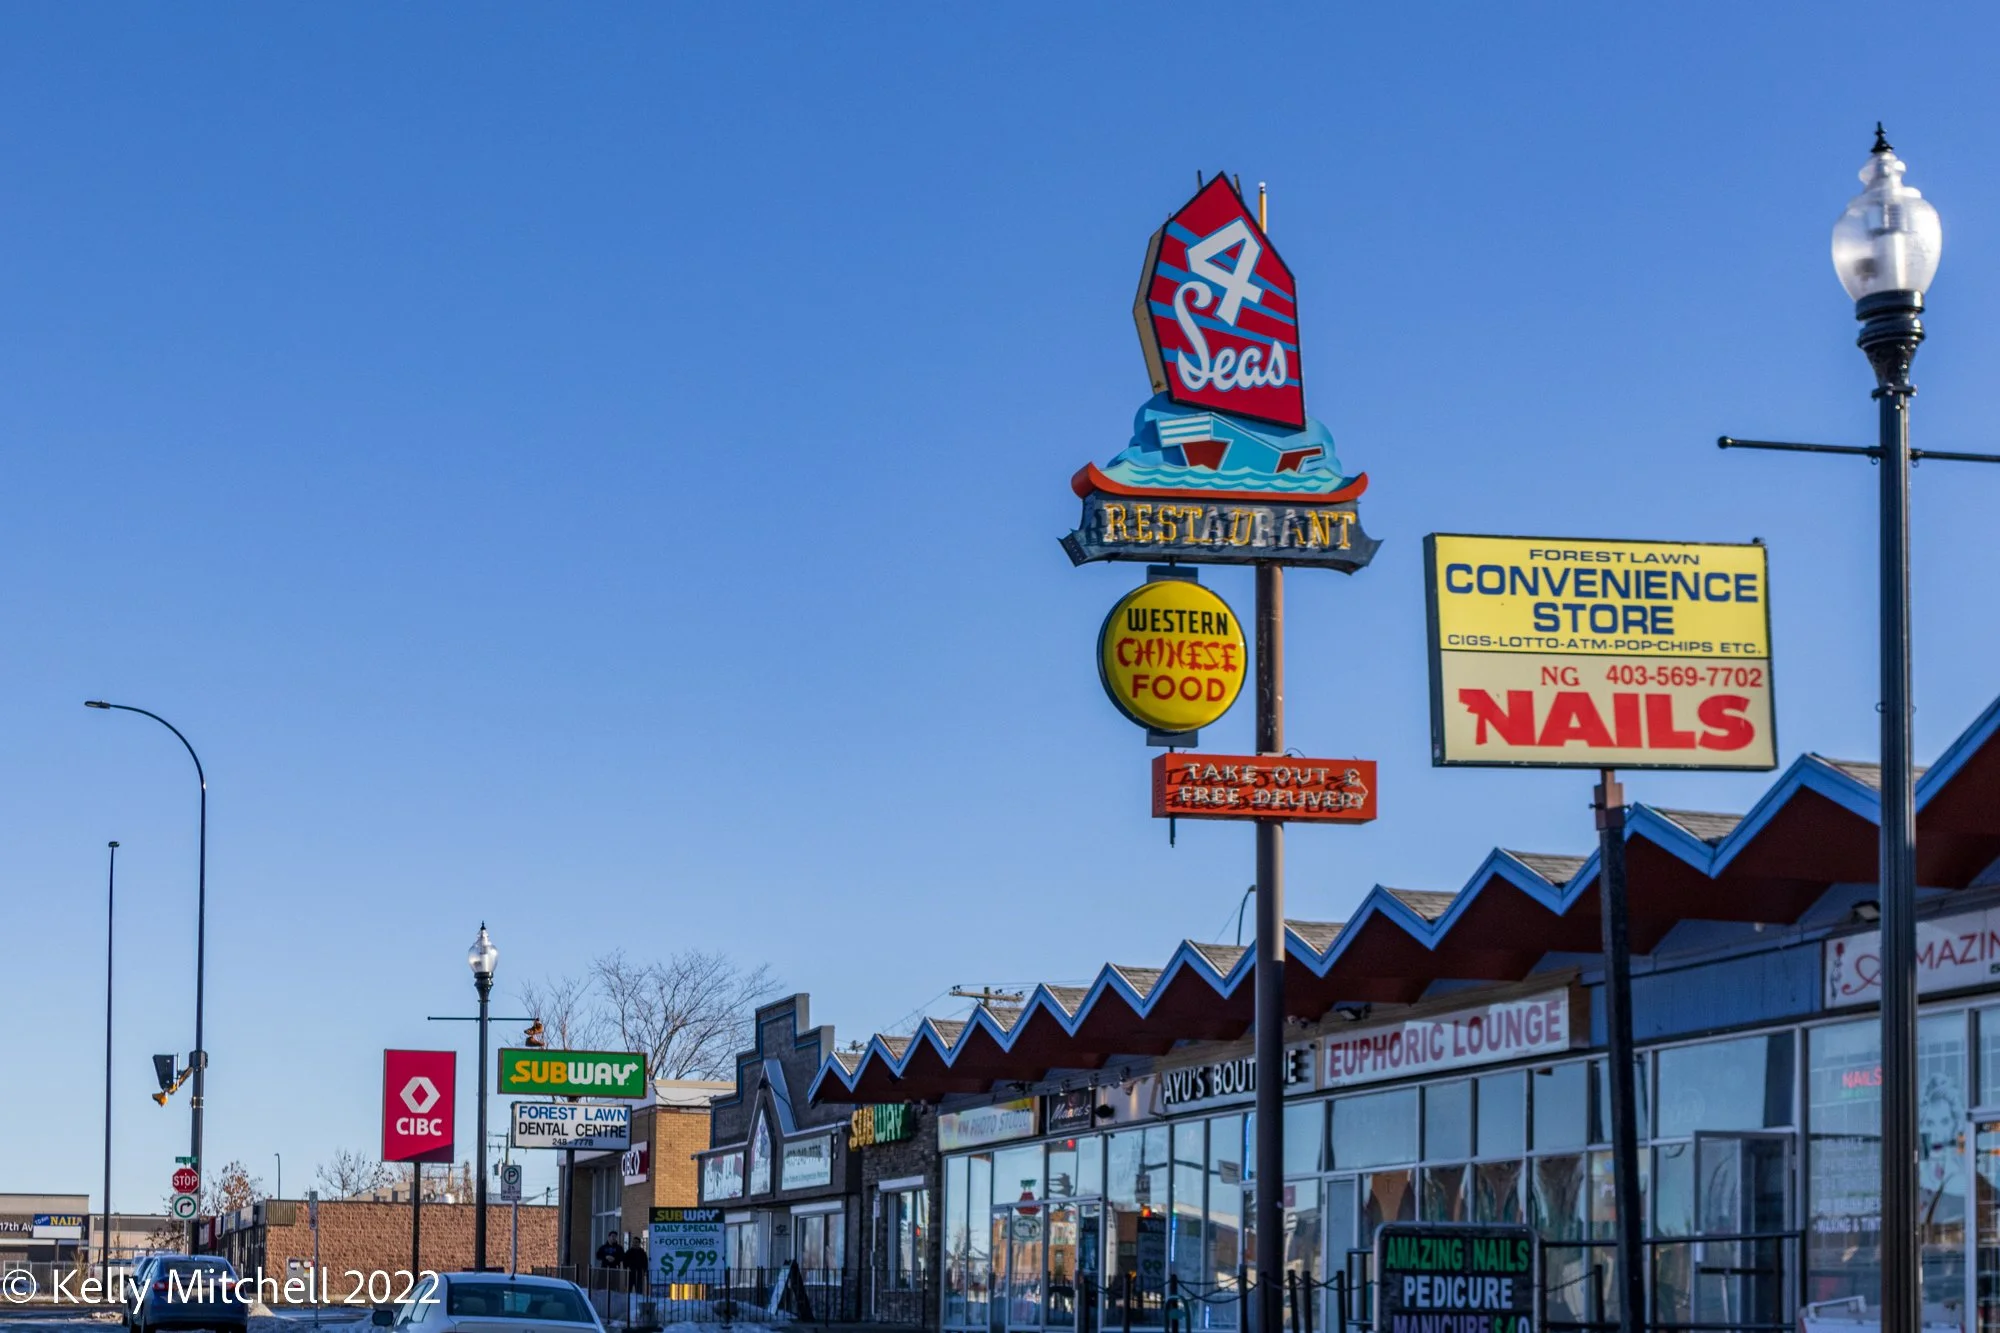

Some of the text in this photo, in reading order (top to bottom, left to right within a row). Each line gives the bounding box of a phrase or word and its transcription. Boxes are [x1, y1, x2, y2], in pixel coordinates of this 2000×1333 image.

[1186, 216, 1263, 326] 4
[1173, 280, 1288, 391] Seas
[1102, 499, 1356, 551] RESTAURANT
[1529, 548, 1700, 566] FOREST LAWN
[1445, 563, 1759, 604] CONVENIENCE
[1127, 606, 1228, 636] WESTERN
[1533, 602, 1675, 635] STORE
[1115, 636, 1238, 673] CHINESE
[1130, 672, 1227, 704] FOOD
[1540, 664, 1763, 689] NG 403-569-7702
[1458, 688, 1756, 752] NAILS
[1183, 762, 1258, 785] TAKE
[1273, 765, 1330, 786] OUT
[1178, 785, 1365, 810] FREE DELIVERY
[1329, 1000, 1561, 1079] EUPHORIC LOUNGE
[509, 1060, 639, 1086] SUBWAY
[1163, 1066, 1206, 1105] AYU'S
[395, 1117, 443, 1137] CIBC
[518, 1105, 628, 1122] FOREST LAWN
[849, 1104, 905, 1151] SUBWAY
[518, 1122, 627, 1139] DENTAL CENTRE
[173, 1175, 198, 1186] STOP
[654, 1209, 720, 1222] SUBWAY
[654, 1224, 720, 1233] DAILY SPECIAL
[659, 1238, 715, 1246] FOOTLONGS
[1386, 1236, 1530, 1272] AMAZING NAILS
